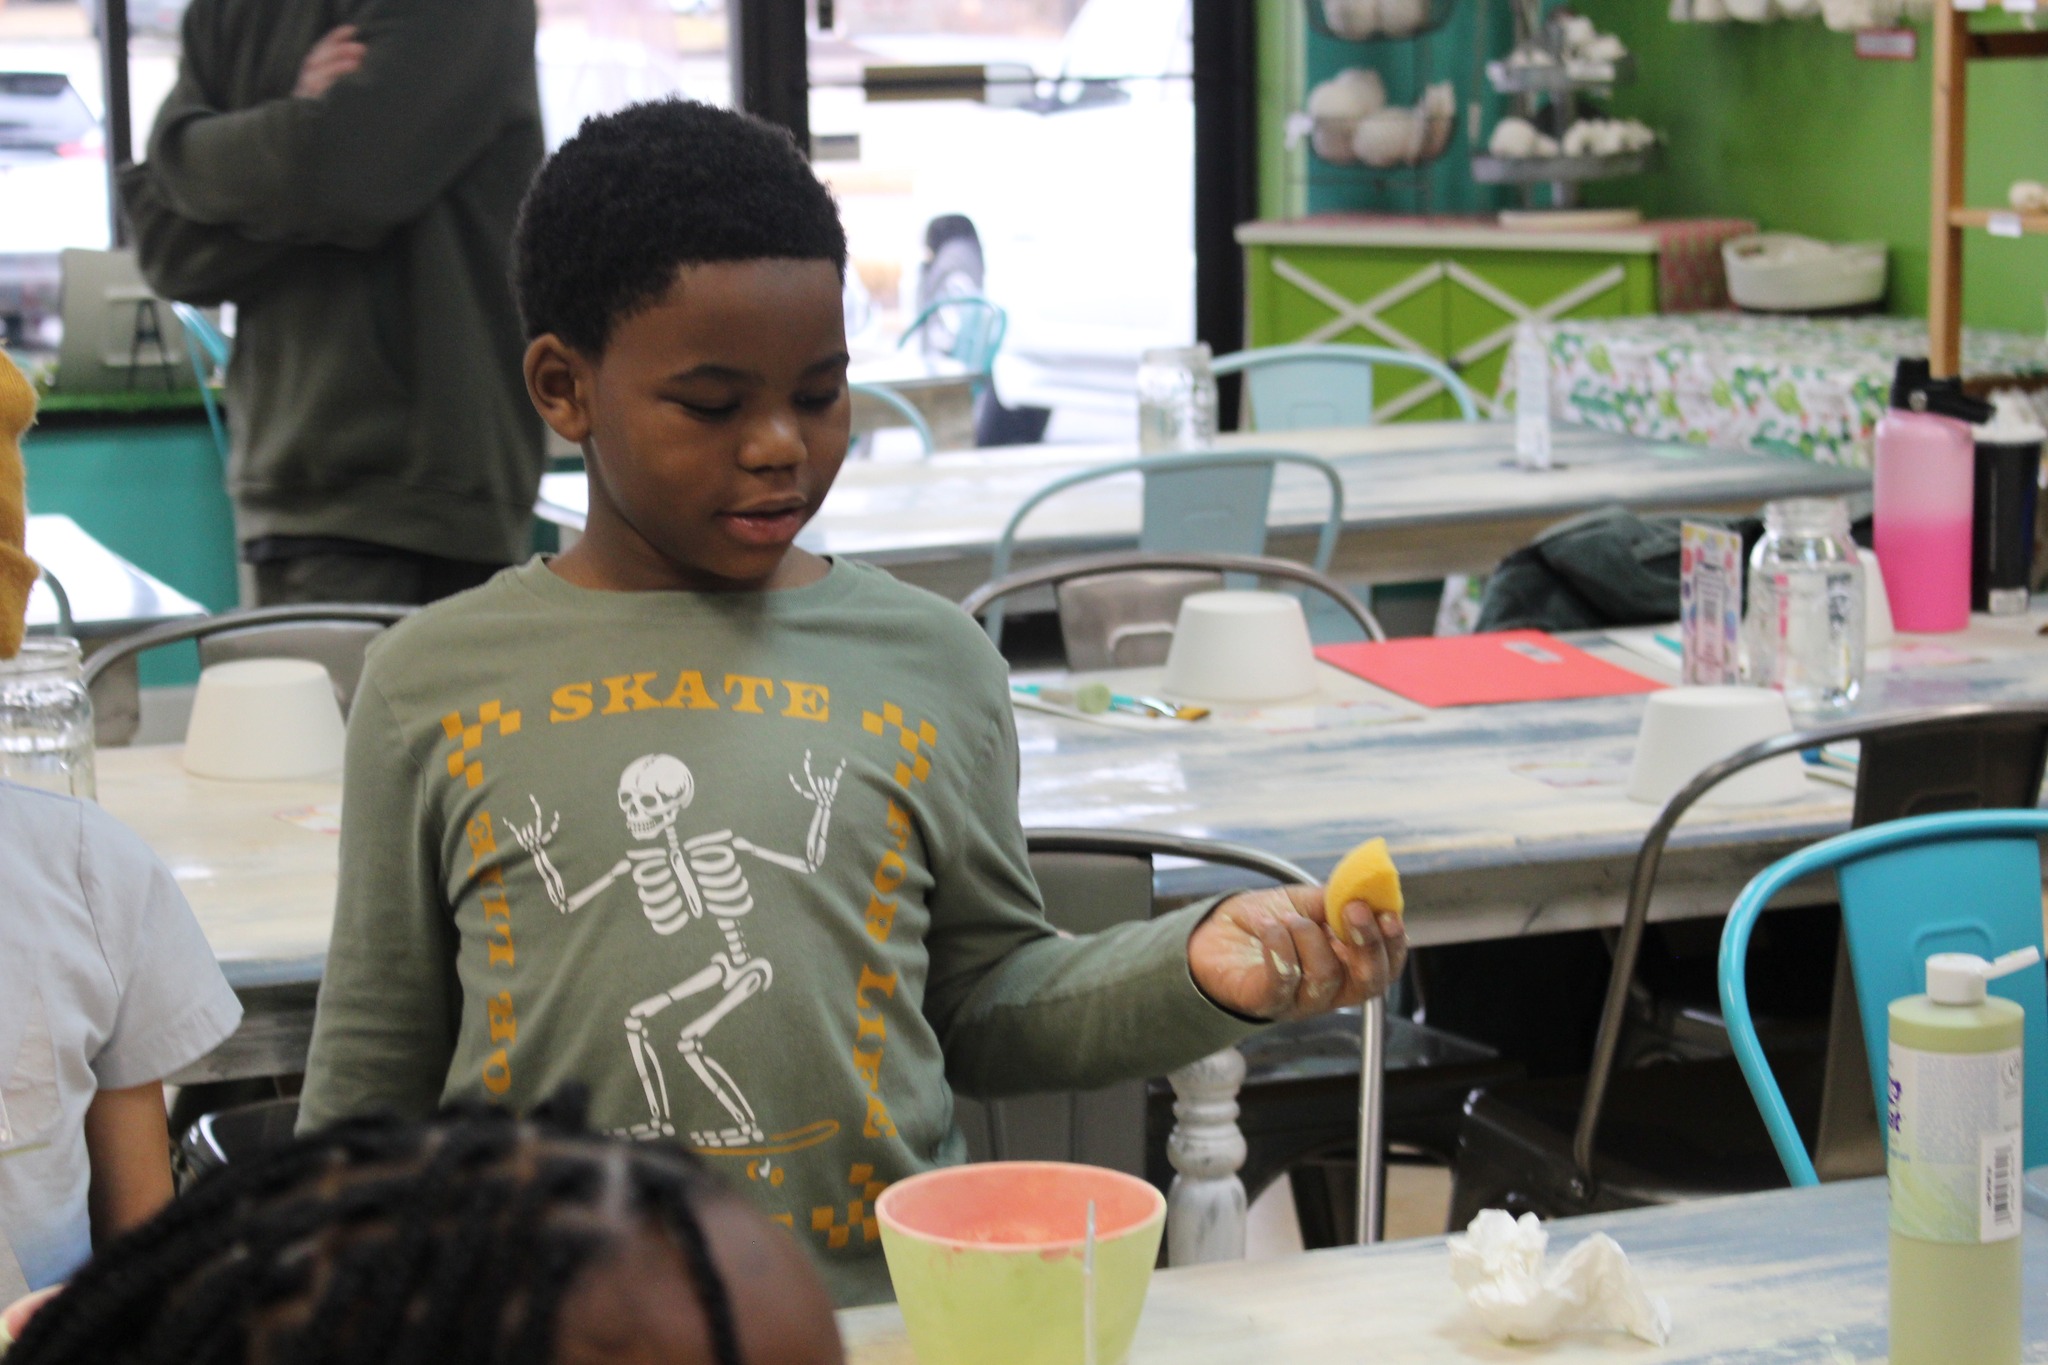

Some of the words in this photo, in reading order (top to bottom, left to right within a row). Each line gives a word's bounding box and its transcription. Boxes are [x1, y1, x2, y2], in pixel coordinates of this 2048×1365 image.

[549, 670, 830, 724] SKATE
[865, 797, 907, 945] FOR
[482, 990, 517, 1103] OR
[853, 963, 898, 1138] LIFE
